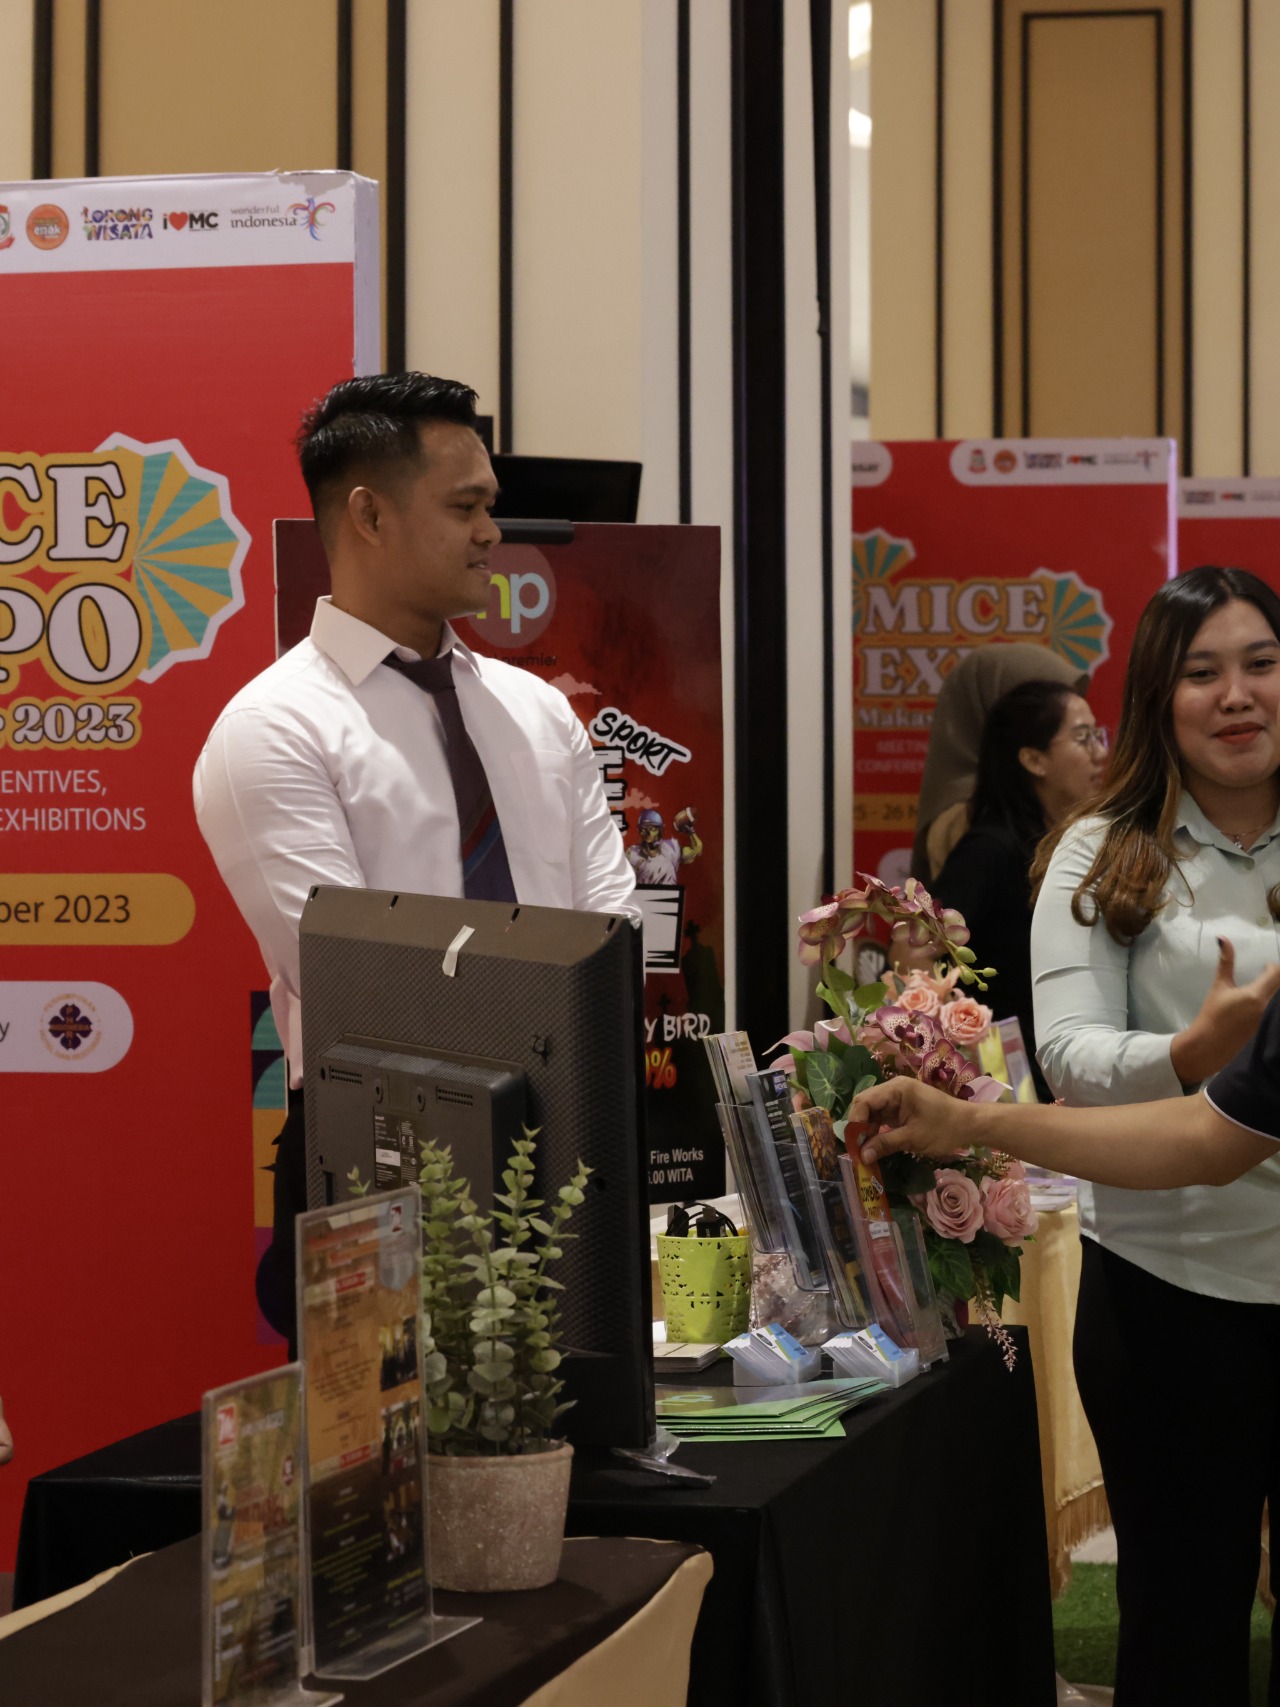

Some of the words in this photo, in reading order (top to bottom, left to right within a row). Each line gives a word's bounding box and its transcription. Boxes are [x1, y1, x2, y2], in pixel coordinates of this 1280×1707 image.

[82, 206, 153, 224] LORONG
[230, 205, 280, 216] wonderful
[83, 222, 153, 241] WISATA
[230, 216, 297, 228] indonesia
[862, 582, 1047, 635] MICE
[862, 647, 972, 696] EX
[13, 703, 136, 744] 2023
[54, 895, 130, 923] 2023
[663, 1013, 711, 1042] BIRD
[650, 1150, 670, 1165] Fire
[671, 1147, 704, 1163] Works
[667, 1168, 694, 1183] WITA
